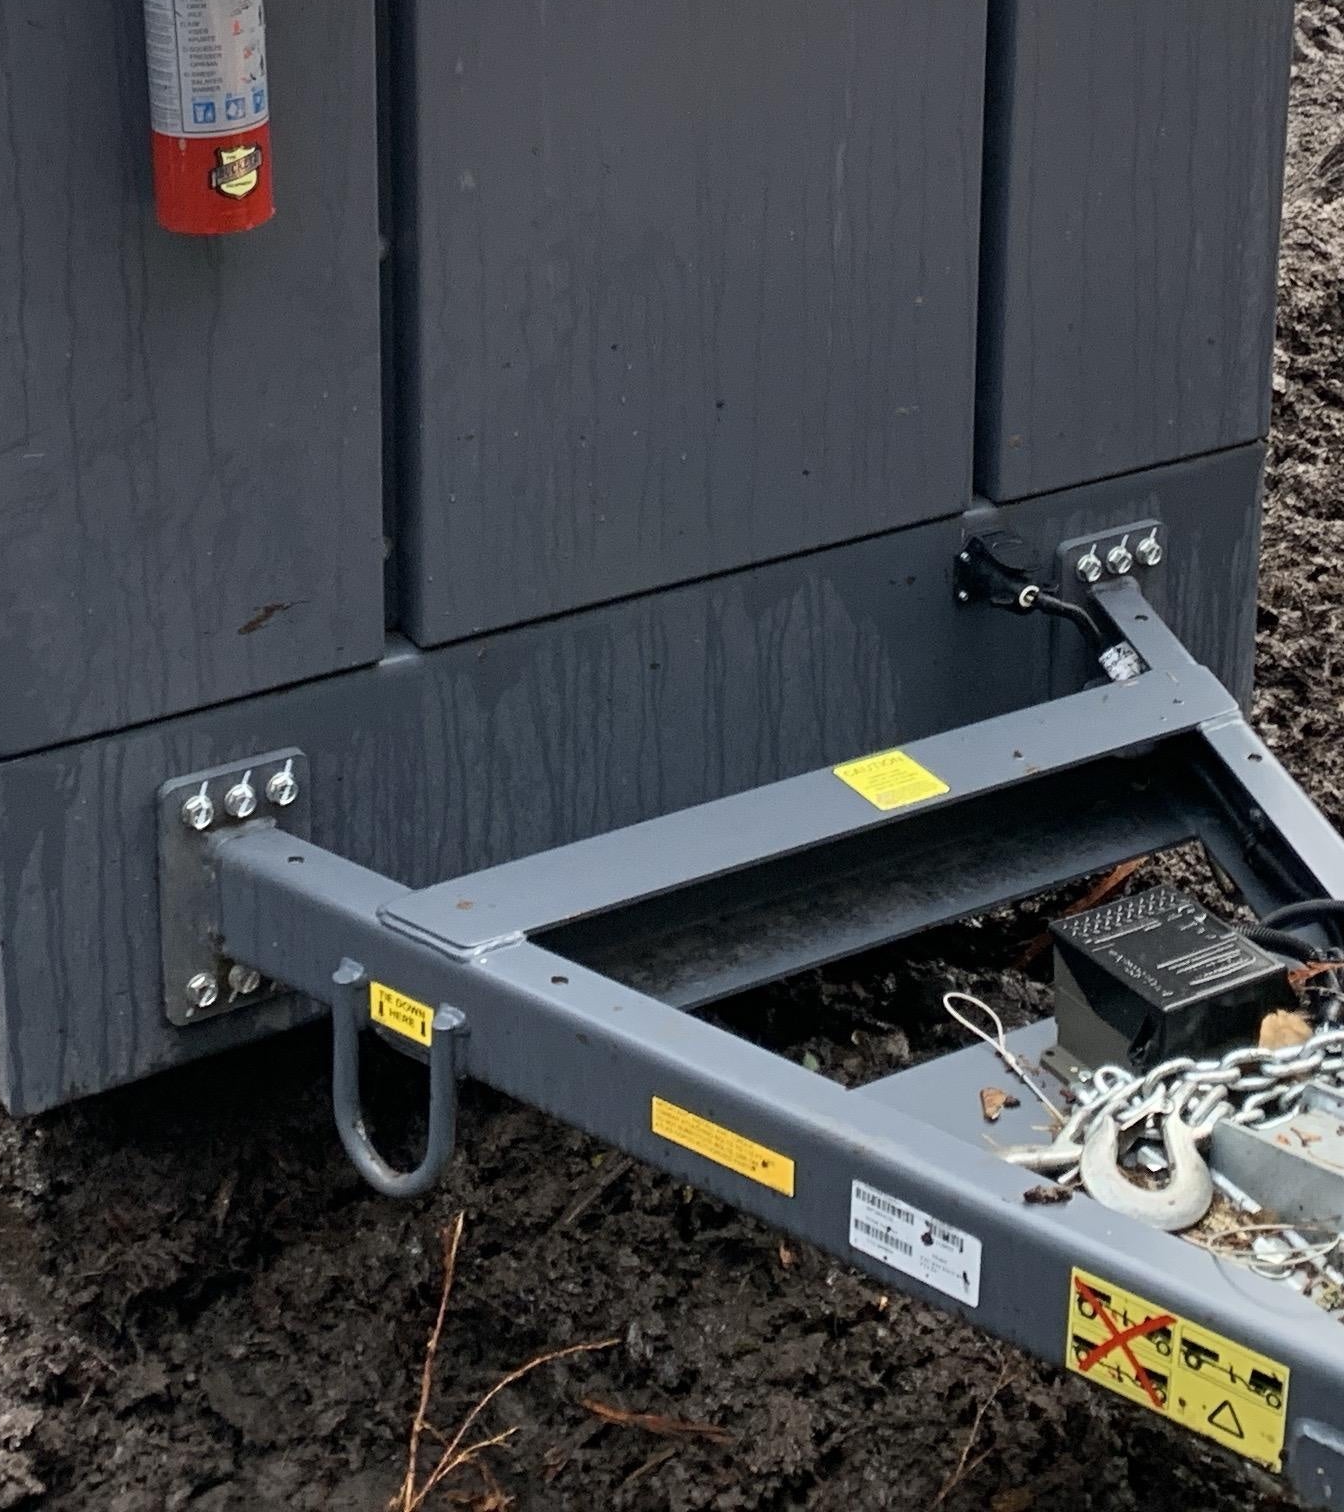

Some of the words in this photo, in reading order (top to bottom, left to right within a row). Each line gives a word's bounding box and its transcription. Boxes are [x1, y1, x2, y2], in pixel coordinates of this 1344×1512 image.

[843, 755, 905, 777] CAUTION
[389, 1007, 415, 1028] HERE
[395, 997, 426, 1019] DOWN
